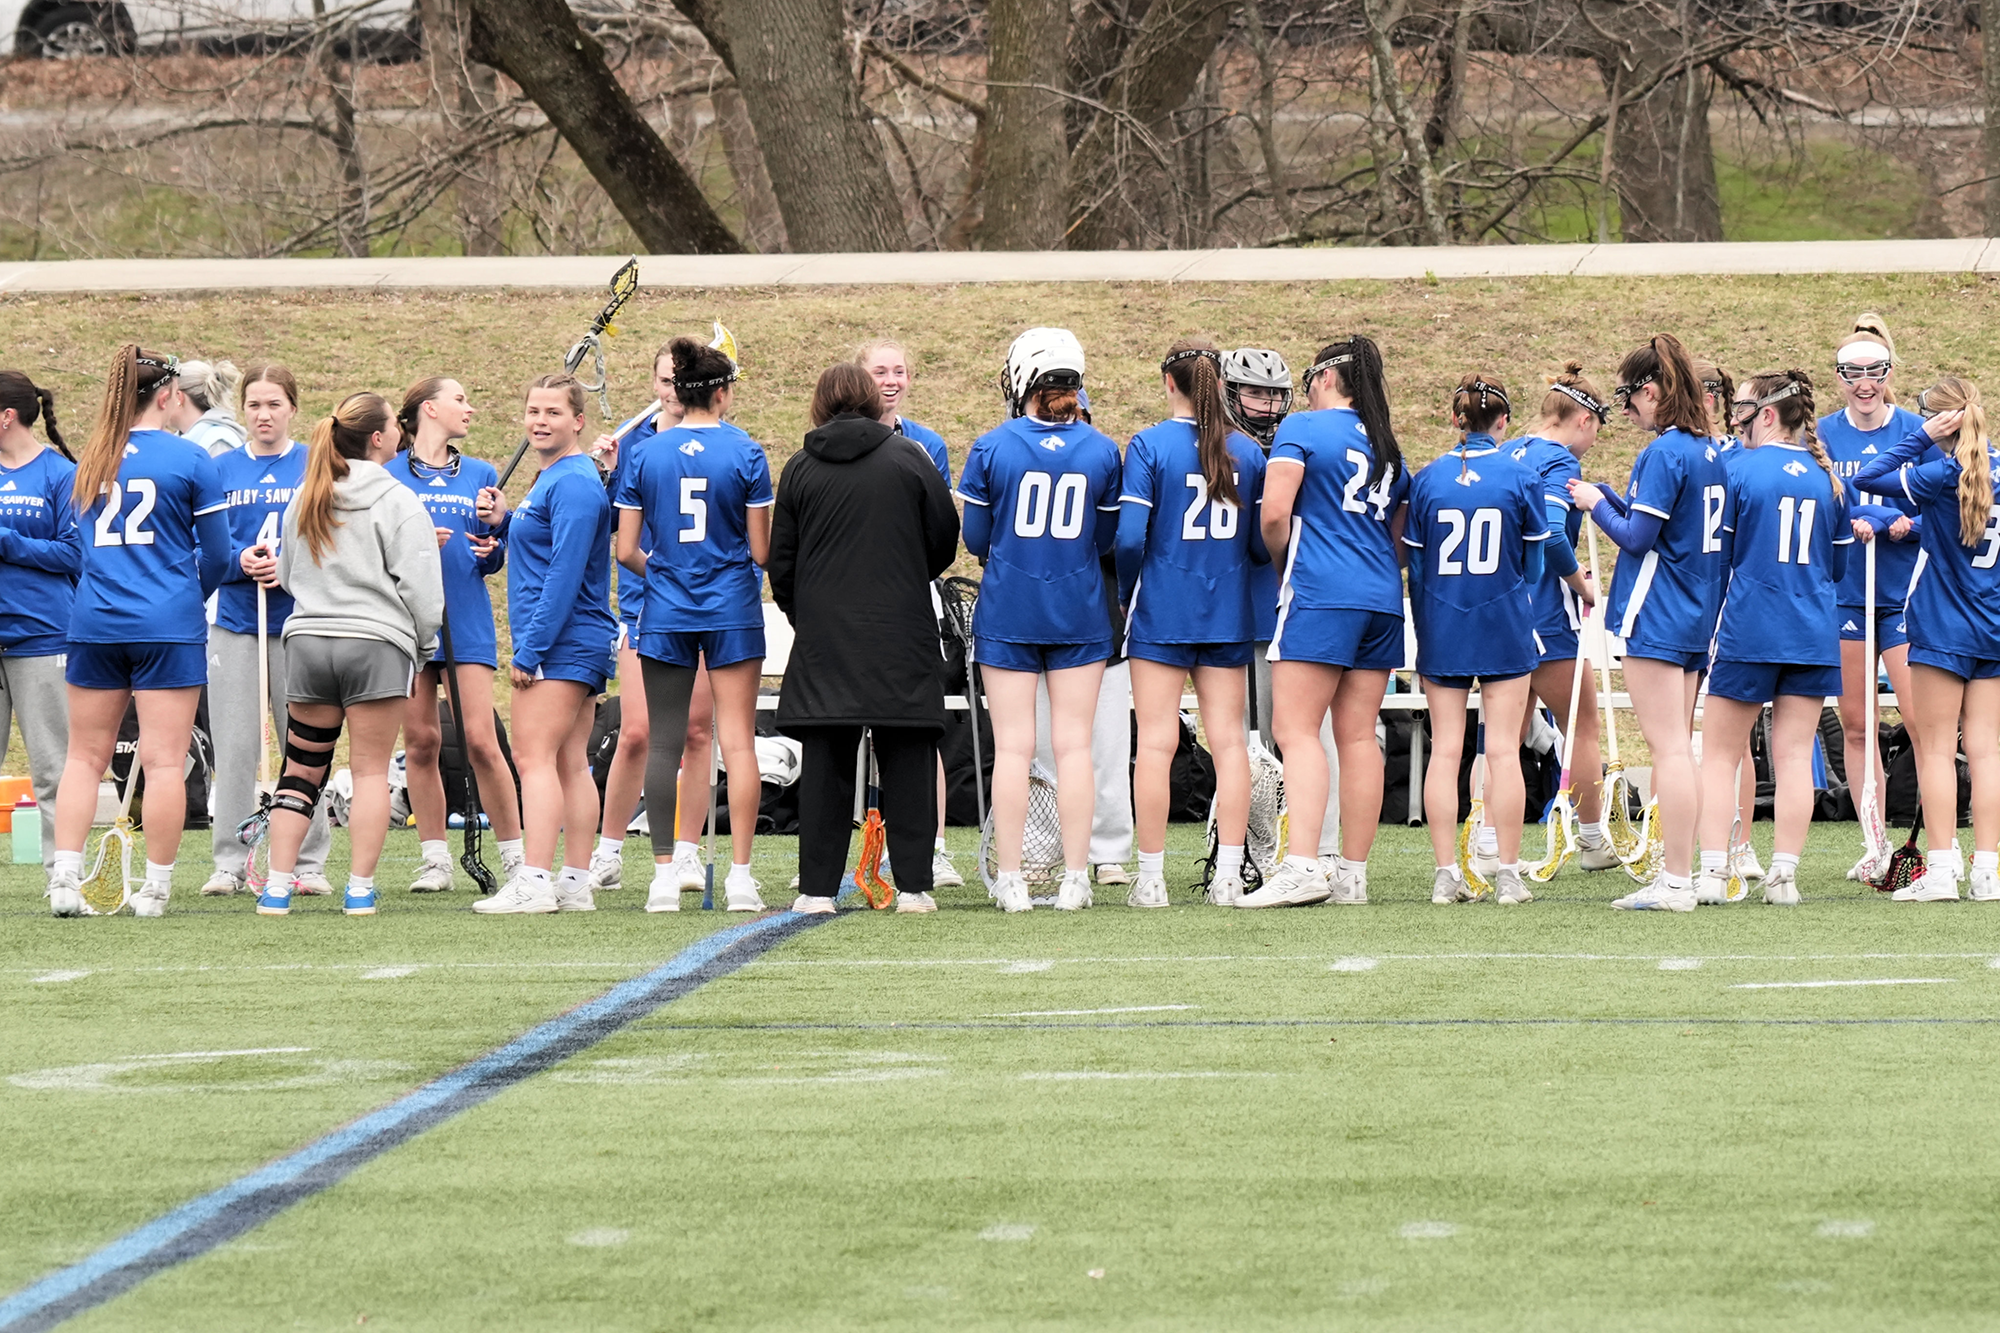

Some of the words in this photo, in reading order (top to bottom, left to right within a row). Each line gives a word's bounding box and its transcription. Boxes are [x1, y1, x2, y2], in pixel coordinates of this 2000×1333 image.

[136, 358, 157, 366] STX
[685, 381, 704, 389] STX
[709, 377, 725, 386] STX
[1179, 350, 1197, 359] STX
[1201, 350, 1217, 360] STX
[1325, 357, 1343, 366] STX
[94, 478, 157, 548] 22
[678, 477, 708, 543] 5
[1014, 470, 1088, 539] 00
[1182, 472, 1239, 540] 26
[1342, 448, 1395, 521] 24
[256, 511, 281, 556] 4
[1437, 508, 1503, 575] 20
[1702, 484, 1726, 554] 12
[1777, 496, 1817, 565] 11
